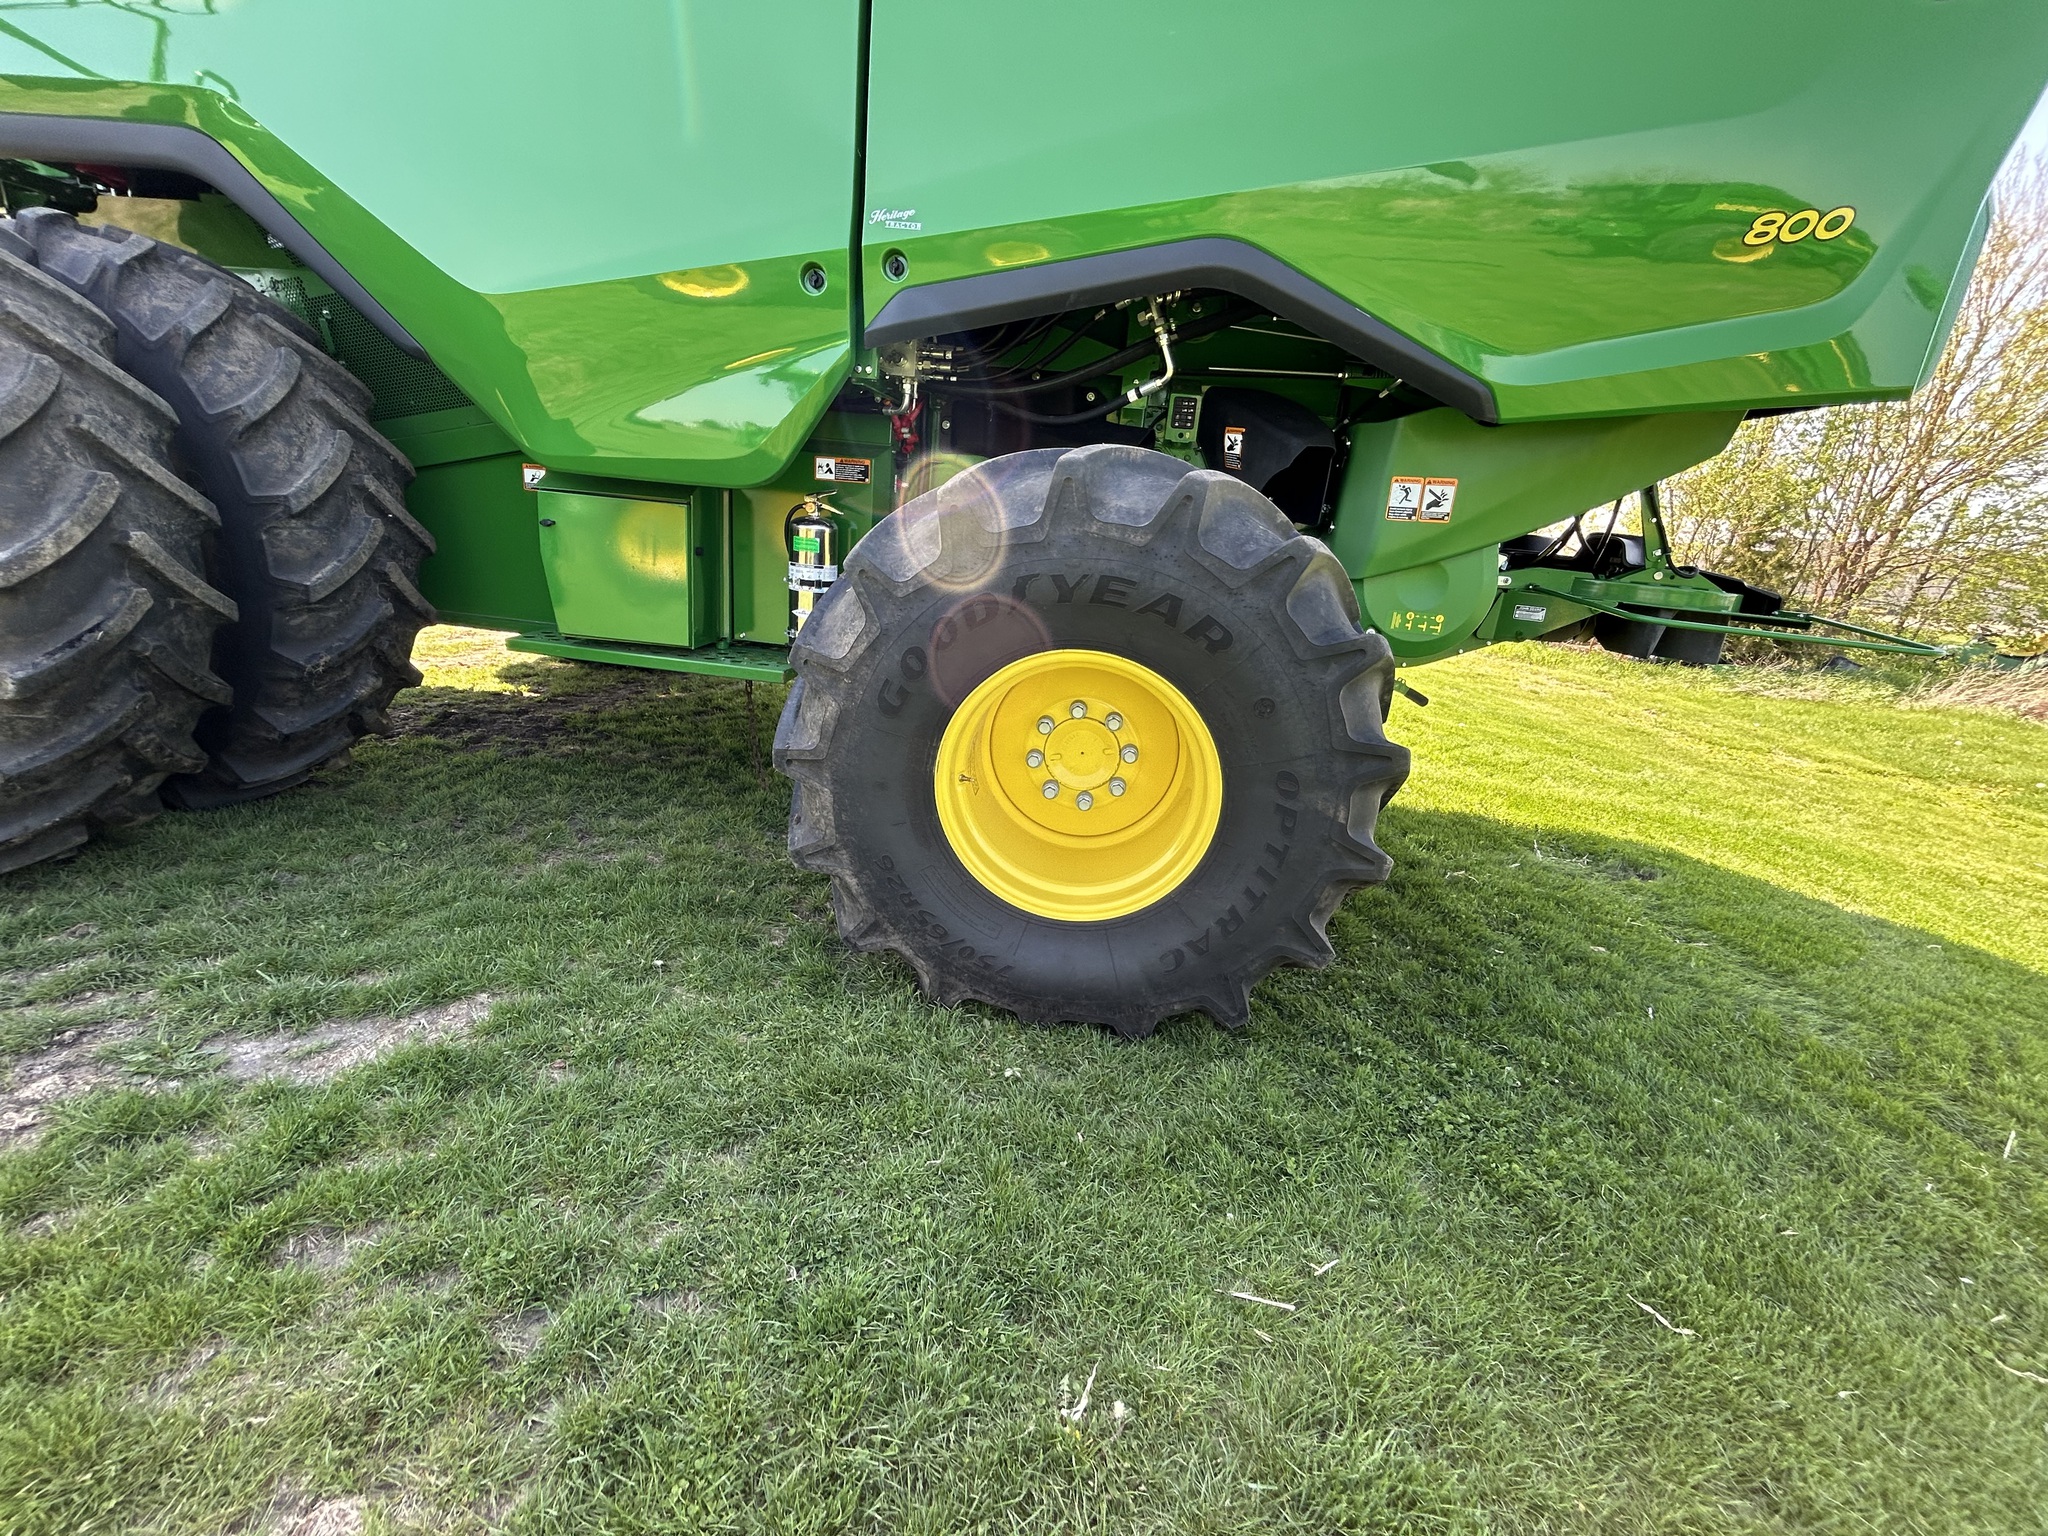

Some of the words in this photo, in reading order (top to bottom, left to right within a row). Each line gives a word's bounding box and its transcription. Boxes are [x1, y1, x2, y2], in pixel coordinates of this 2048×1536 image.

[869, 208, 915, 224] Heritage
[886, 221, 921, 230] TRACTOR
[1743, 206, 1856, 246] 800
[878, 573, 1234, 718] GOODYEAR
[1159, 770, 1299, 974] OPTITRAC
